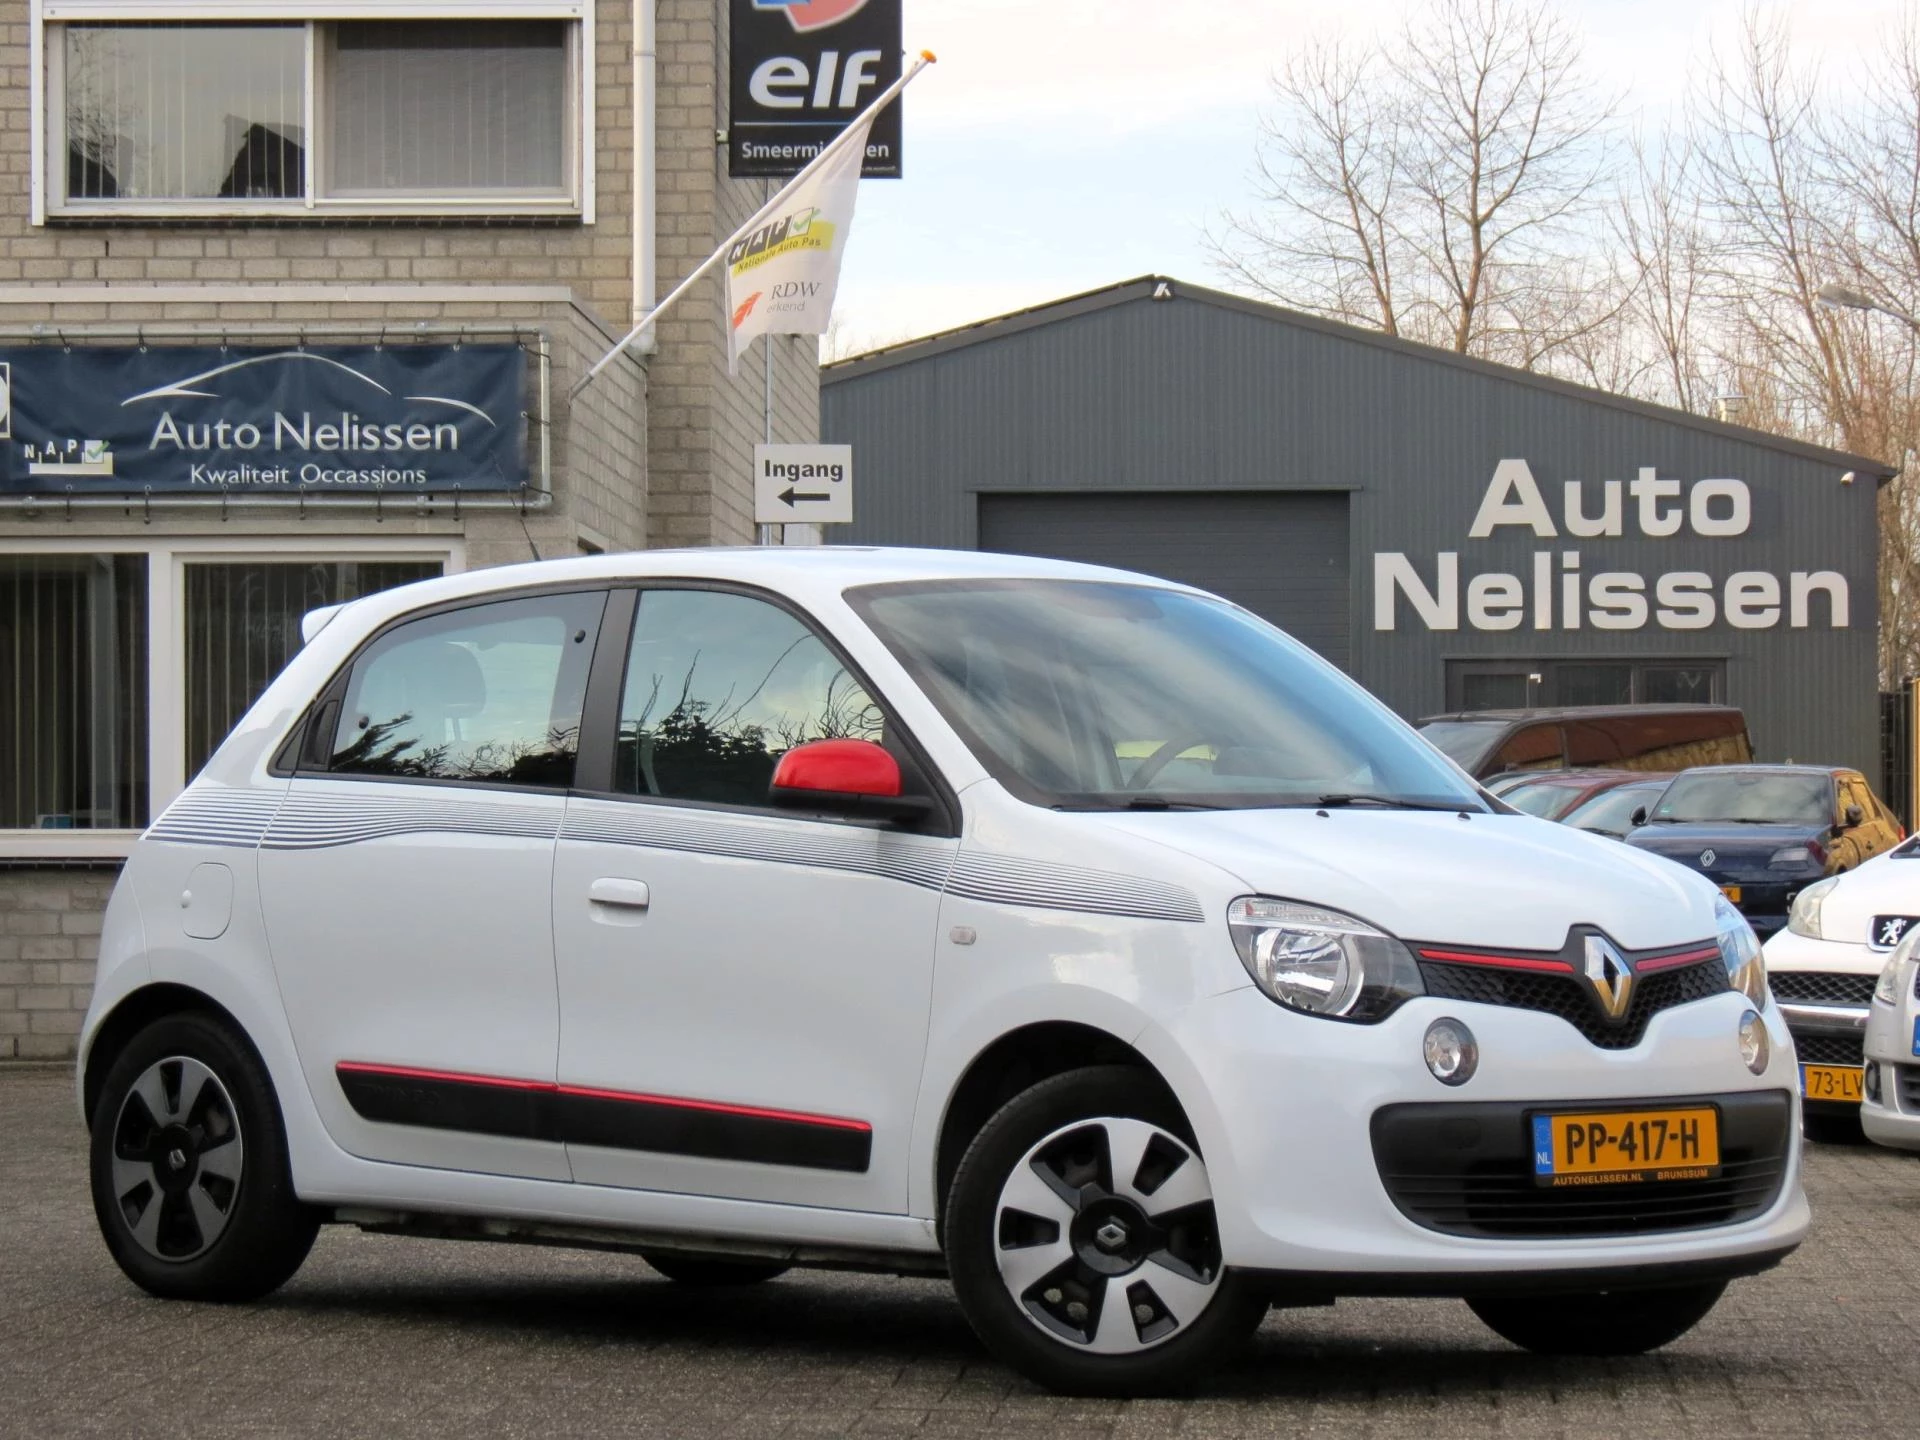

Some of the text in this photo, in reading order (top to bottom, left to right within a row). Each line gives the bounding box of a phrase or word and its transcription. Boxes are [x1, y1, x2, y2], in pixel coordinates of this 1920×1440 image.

[750, 50, 881, 109] elf
[777, 240, 799, 254] Auto
[802, 237, 821, 247] Pas
[772, 282, 820, 299] RDW
[150, 411, 458, 450] Auto Nelissen
[191, 463, 426, 484] Kwaliteit Occassions
[765, 459, 843, 482] Ingang
[1468, 459, 1751, 537] Auto
[1374, 551, 1849, 631] Nelissen
[1566, 1118, 1699, 1165] PP-417-H
[1537, 1152, 1551, 1165] NL
[1553, 1168, 1708, 1187] AUTONELISSEN.NL BRUNSSUM
